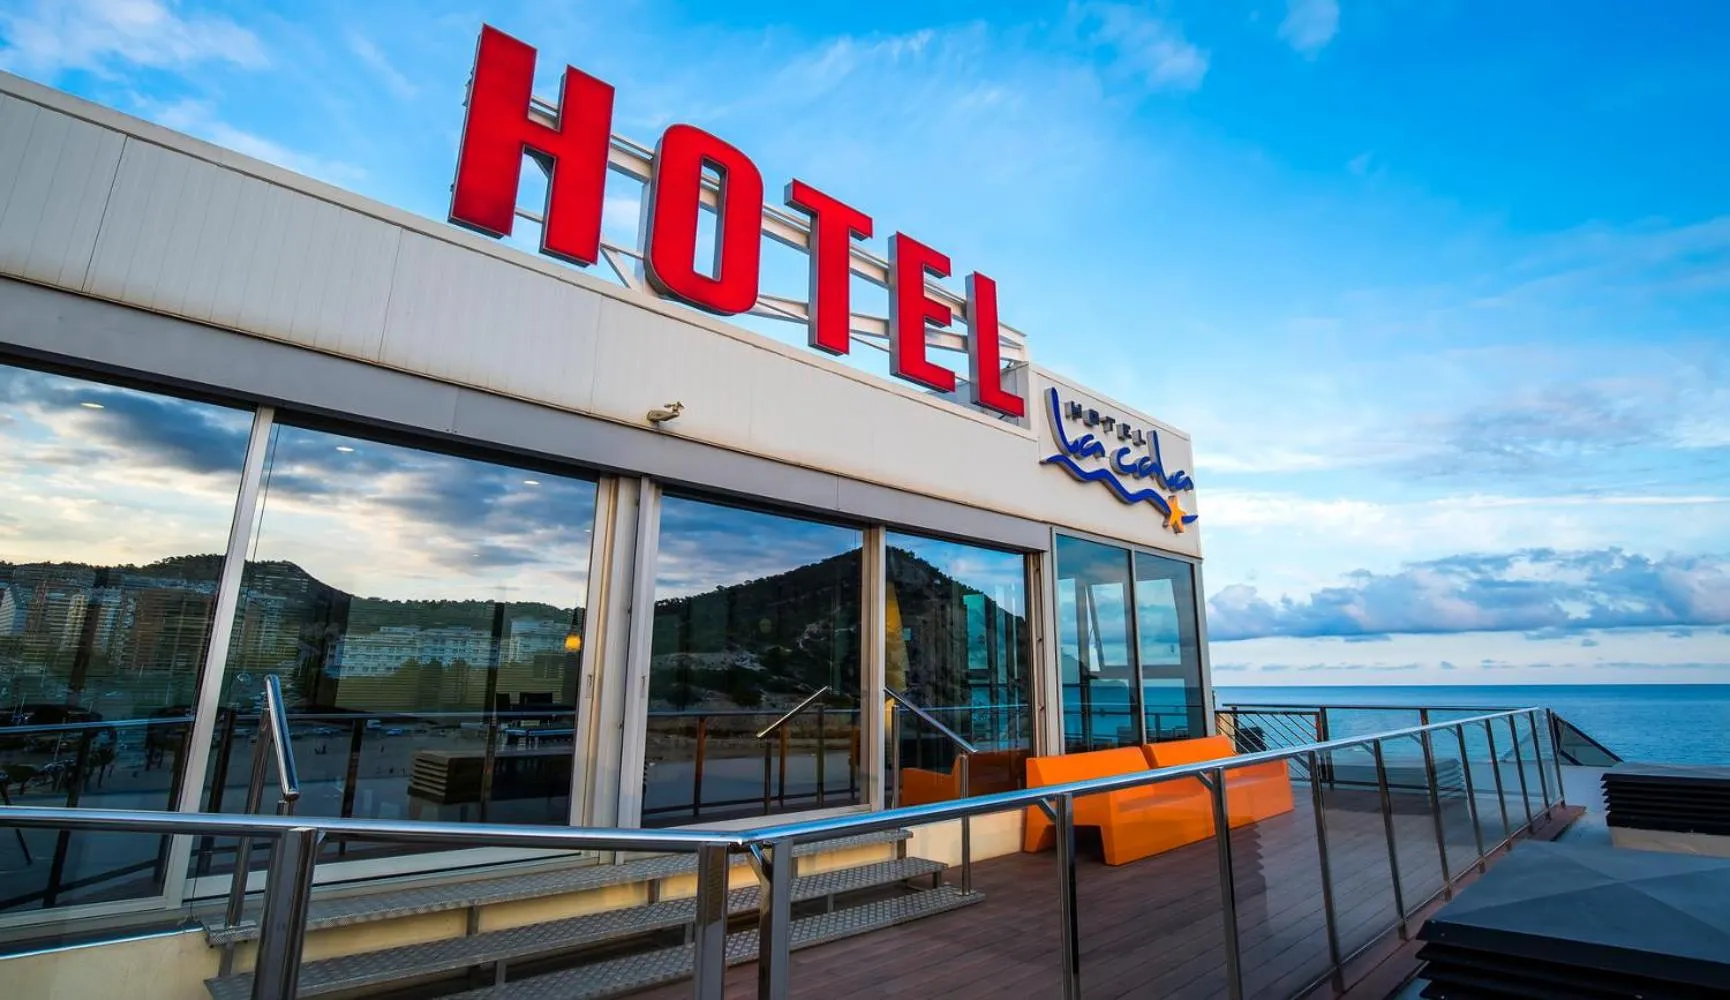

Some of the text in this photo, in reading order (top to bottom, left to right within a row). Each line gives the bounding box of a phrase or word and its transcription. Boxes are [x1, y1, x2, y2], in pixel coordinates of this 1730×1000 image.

[448, 24, 1025, 417] HOTEL
[1045, 387, 1106, 460] La
[1065, 401, 1147, 446] HOTEL
